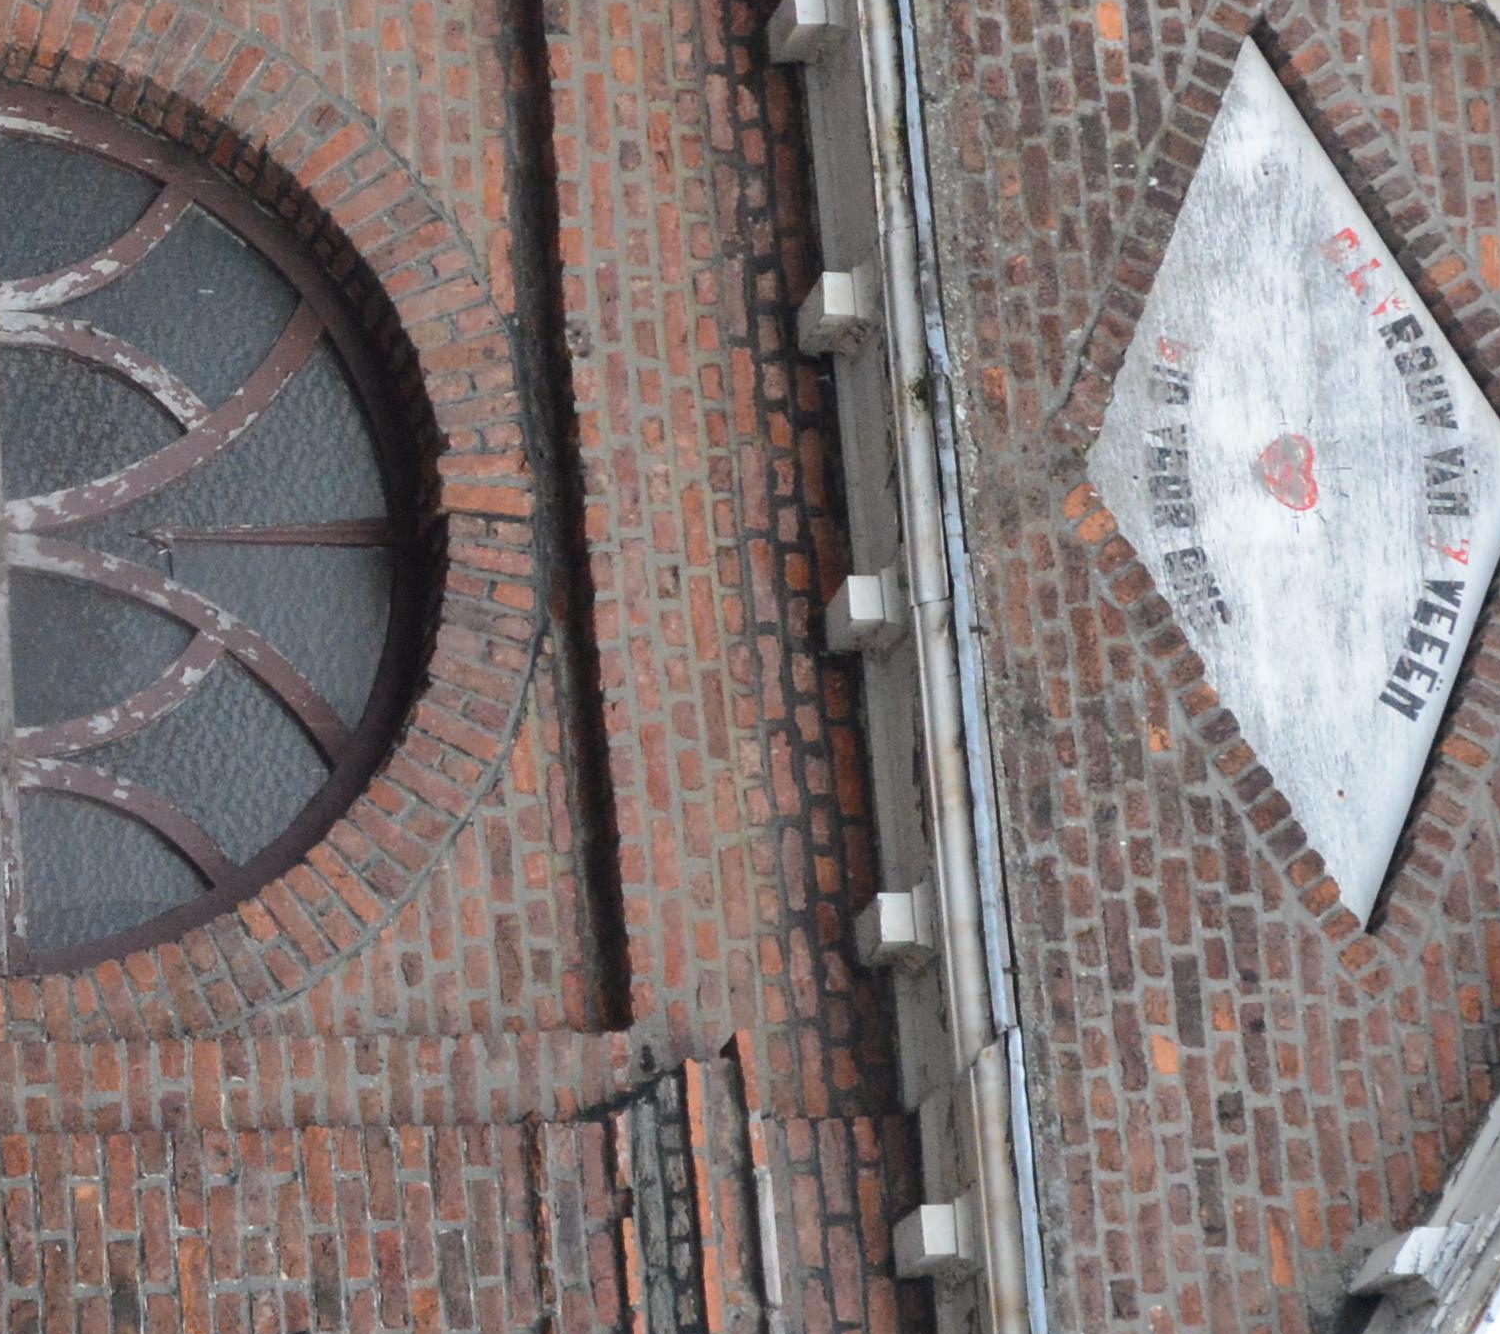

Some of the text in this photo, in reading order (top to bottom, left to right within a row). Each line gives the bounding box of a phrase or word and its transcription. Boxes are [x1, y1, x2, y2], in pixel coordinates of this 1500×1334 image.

[1147, 424, 1197, 530] VOOR
[1423, 446, 1470, 516] VAN
[1164, 546, 1232, 631] ONS
[1427, 537, 1470, 566] 7
[1378, 579, 1466, 722] WEEËN
